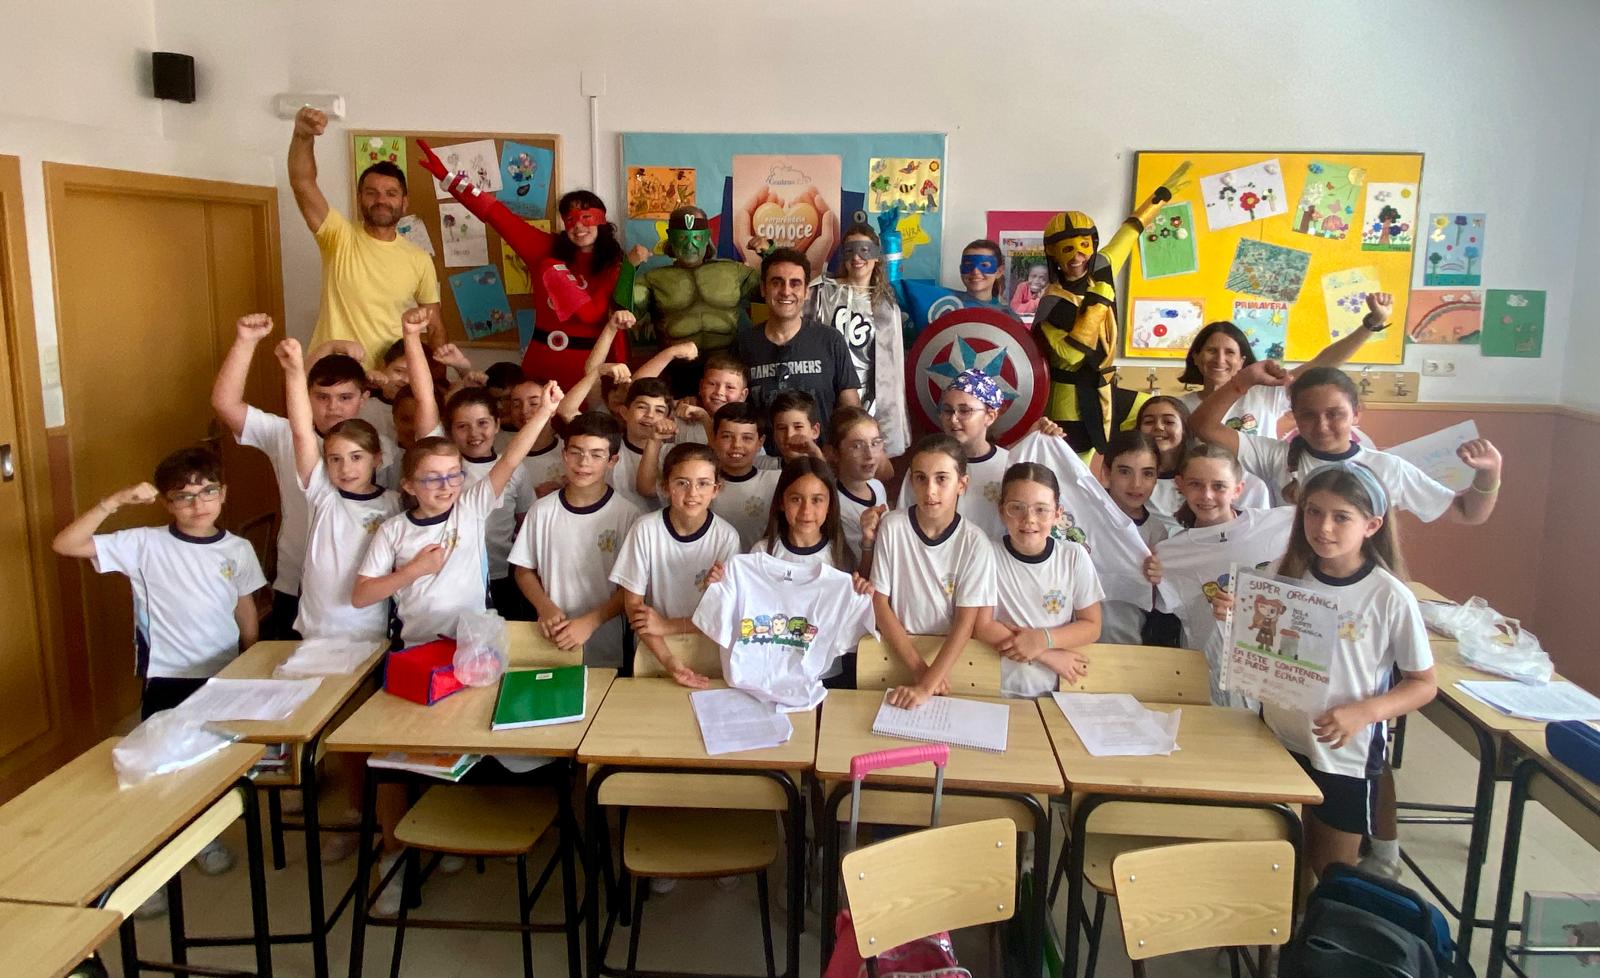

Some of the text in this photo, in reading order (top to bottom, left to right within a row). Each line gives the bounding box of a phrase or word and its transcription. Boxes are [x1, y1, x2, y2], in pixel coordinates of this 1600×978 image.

[757, 223, 813, 240] conoce
[1235, 301, 1287, 309] PRIMAVERA
[750, 359, 822, 379] RANSRMERS
[1249, 580, 1281, 595] SUPER
[1232, 654, 1243, 664] SE
[1244, 658, 1270, 672] PUEDE
[1246, 650, 1269, 665] ESTE
[1274, 660, 1330, 684] CONTENEDOR
